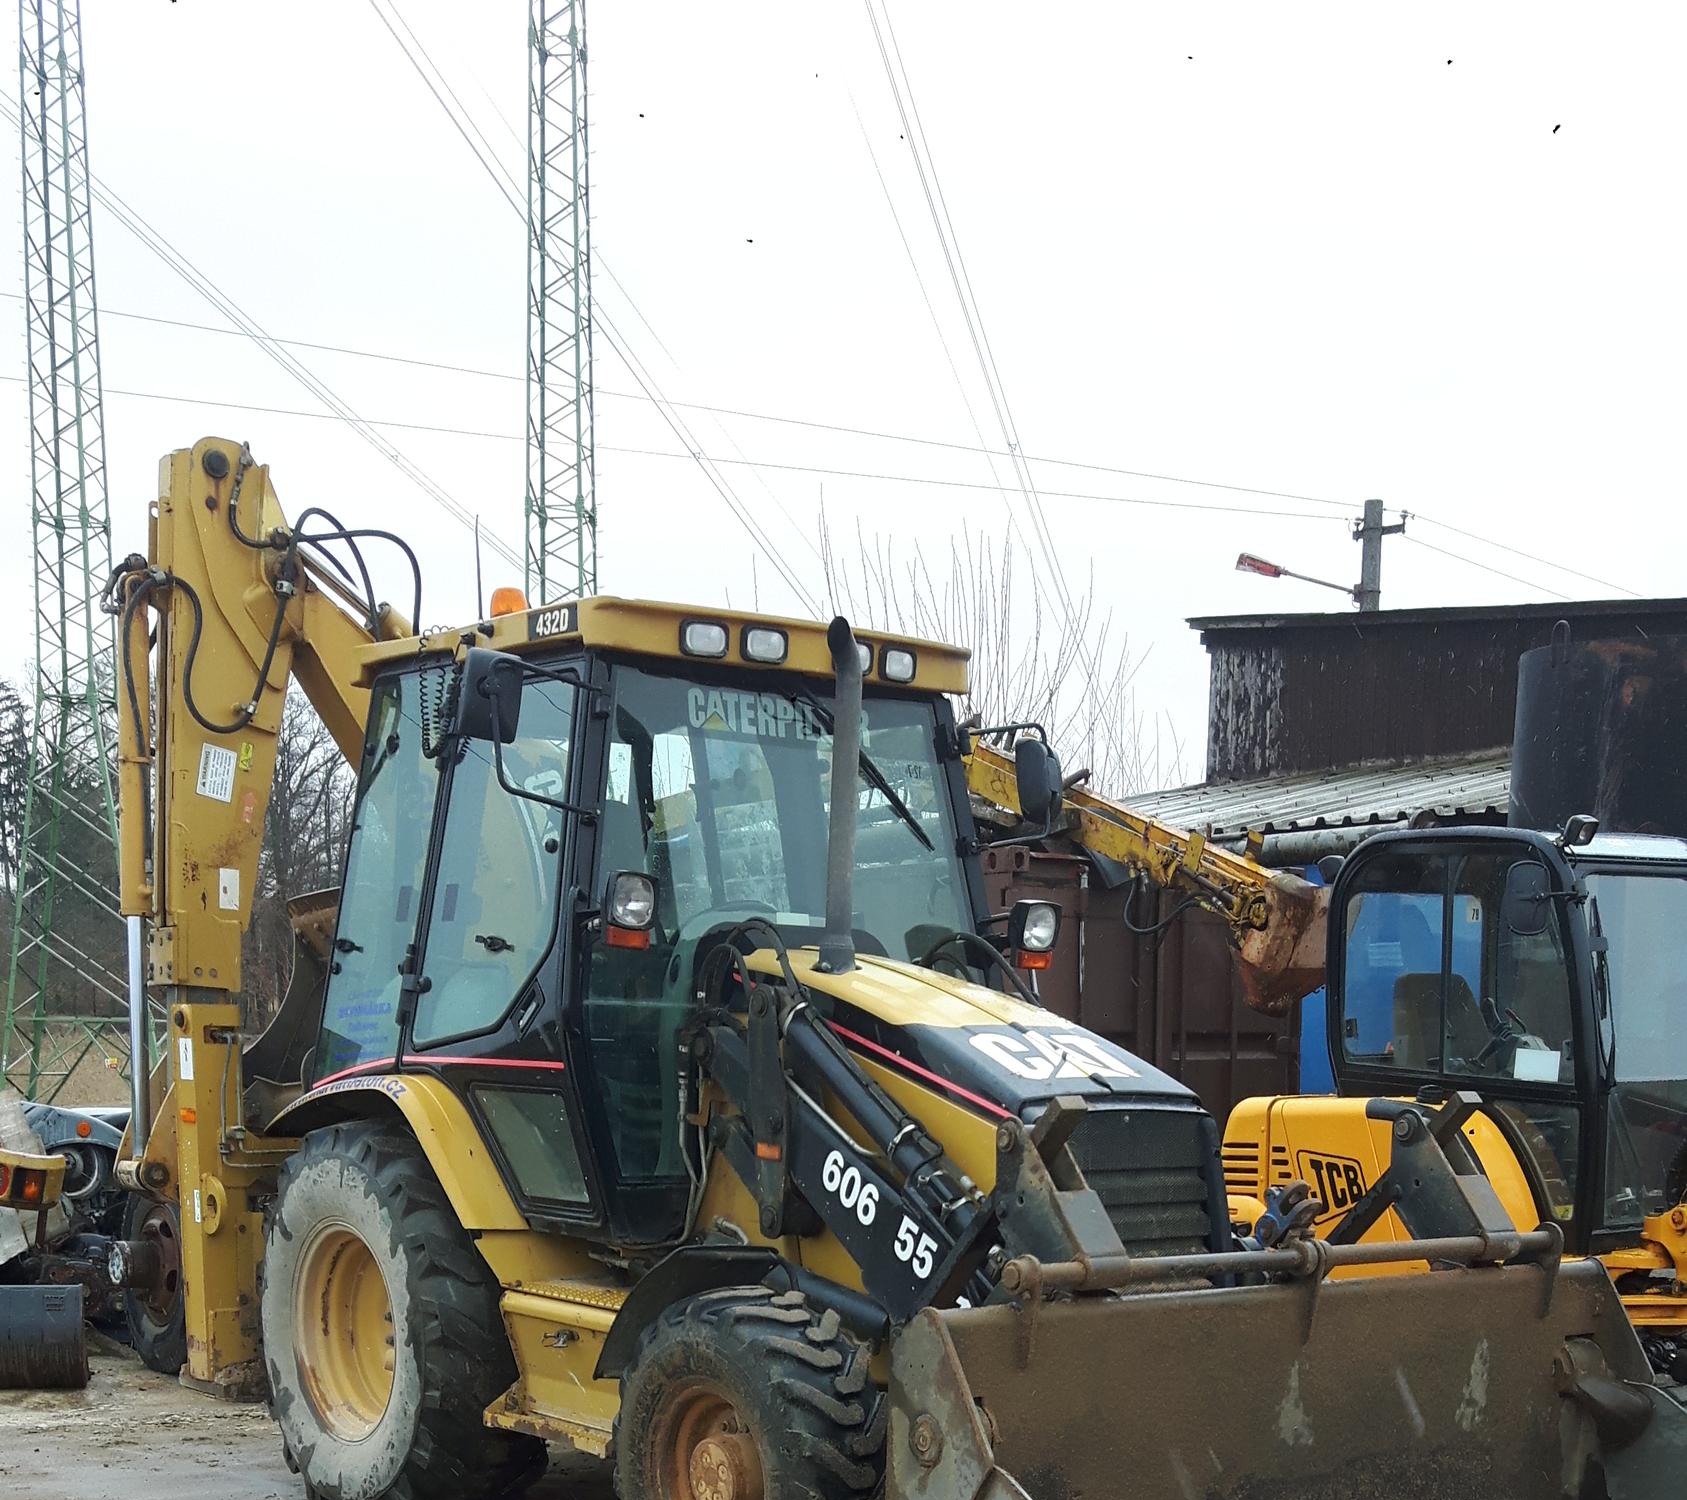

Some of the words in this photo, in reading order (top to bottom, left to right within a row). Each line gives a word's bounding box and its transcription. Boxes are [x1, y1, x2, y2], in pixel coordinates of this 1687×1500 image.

[536, 608, 569, 636] 432D
[968, 1030, 1144, 1080] CAT
[1309, 1159, 1363, 1216] JCB
[823, 1150, 880, 1226] 606
[894, 1215, 939, 1279] 55
